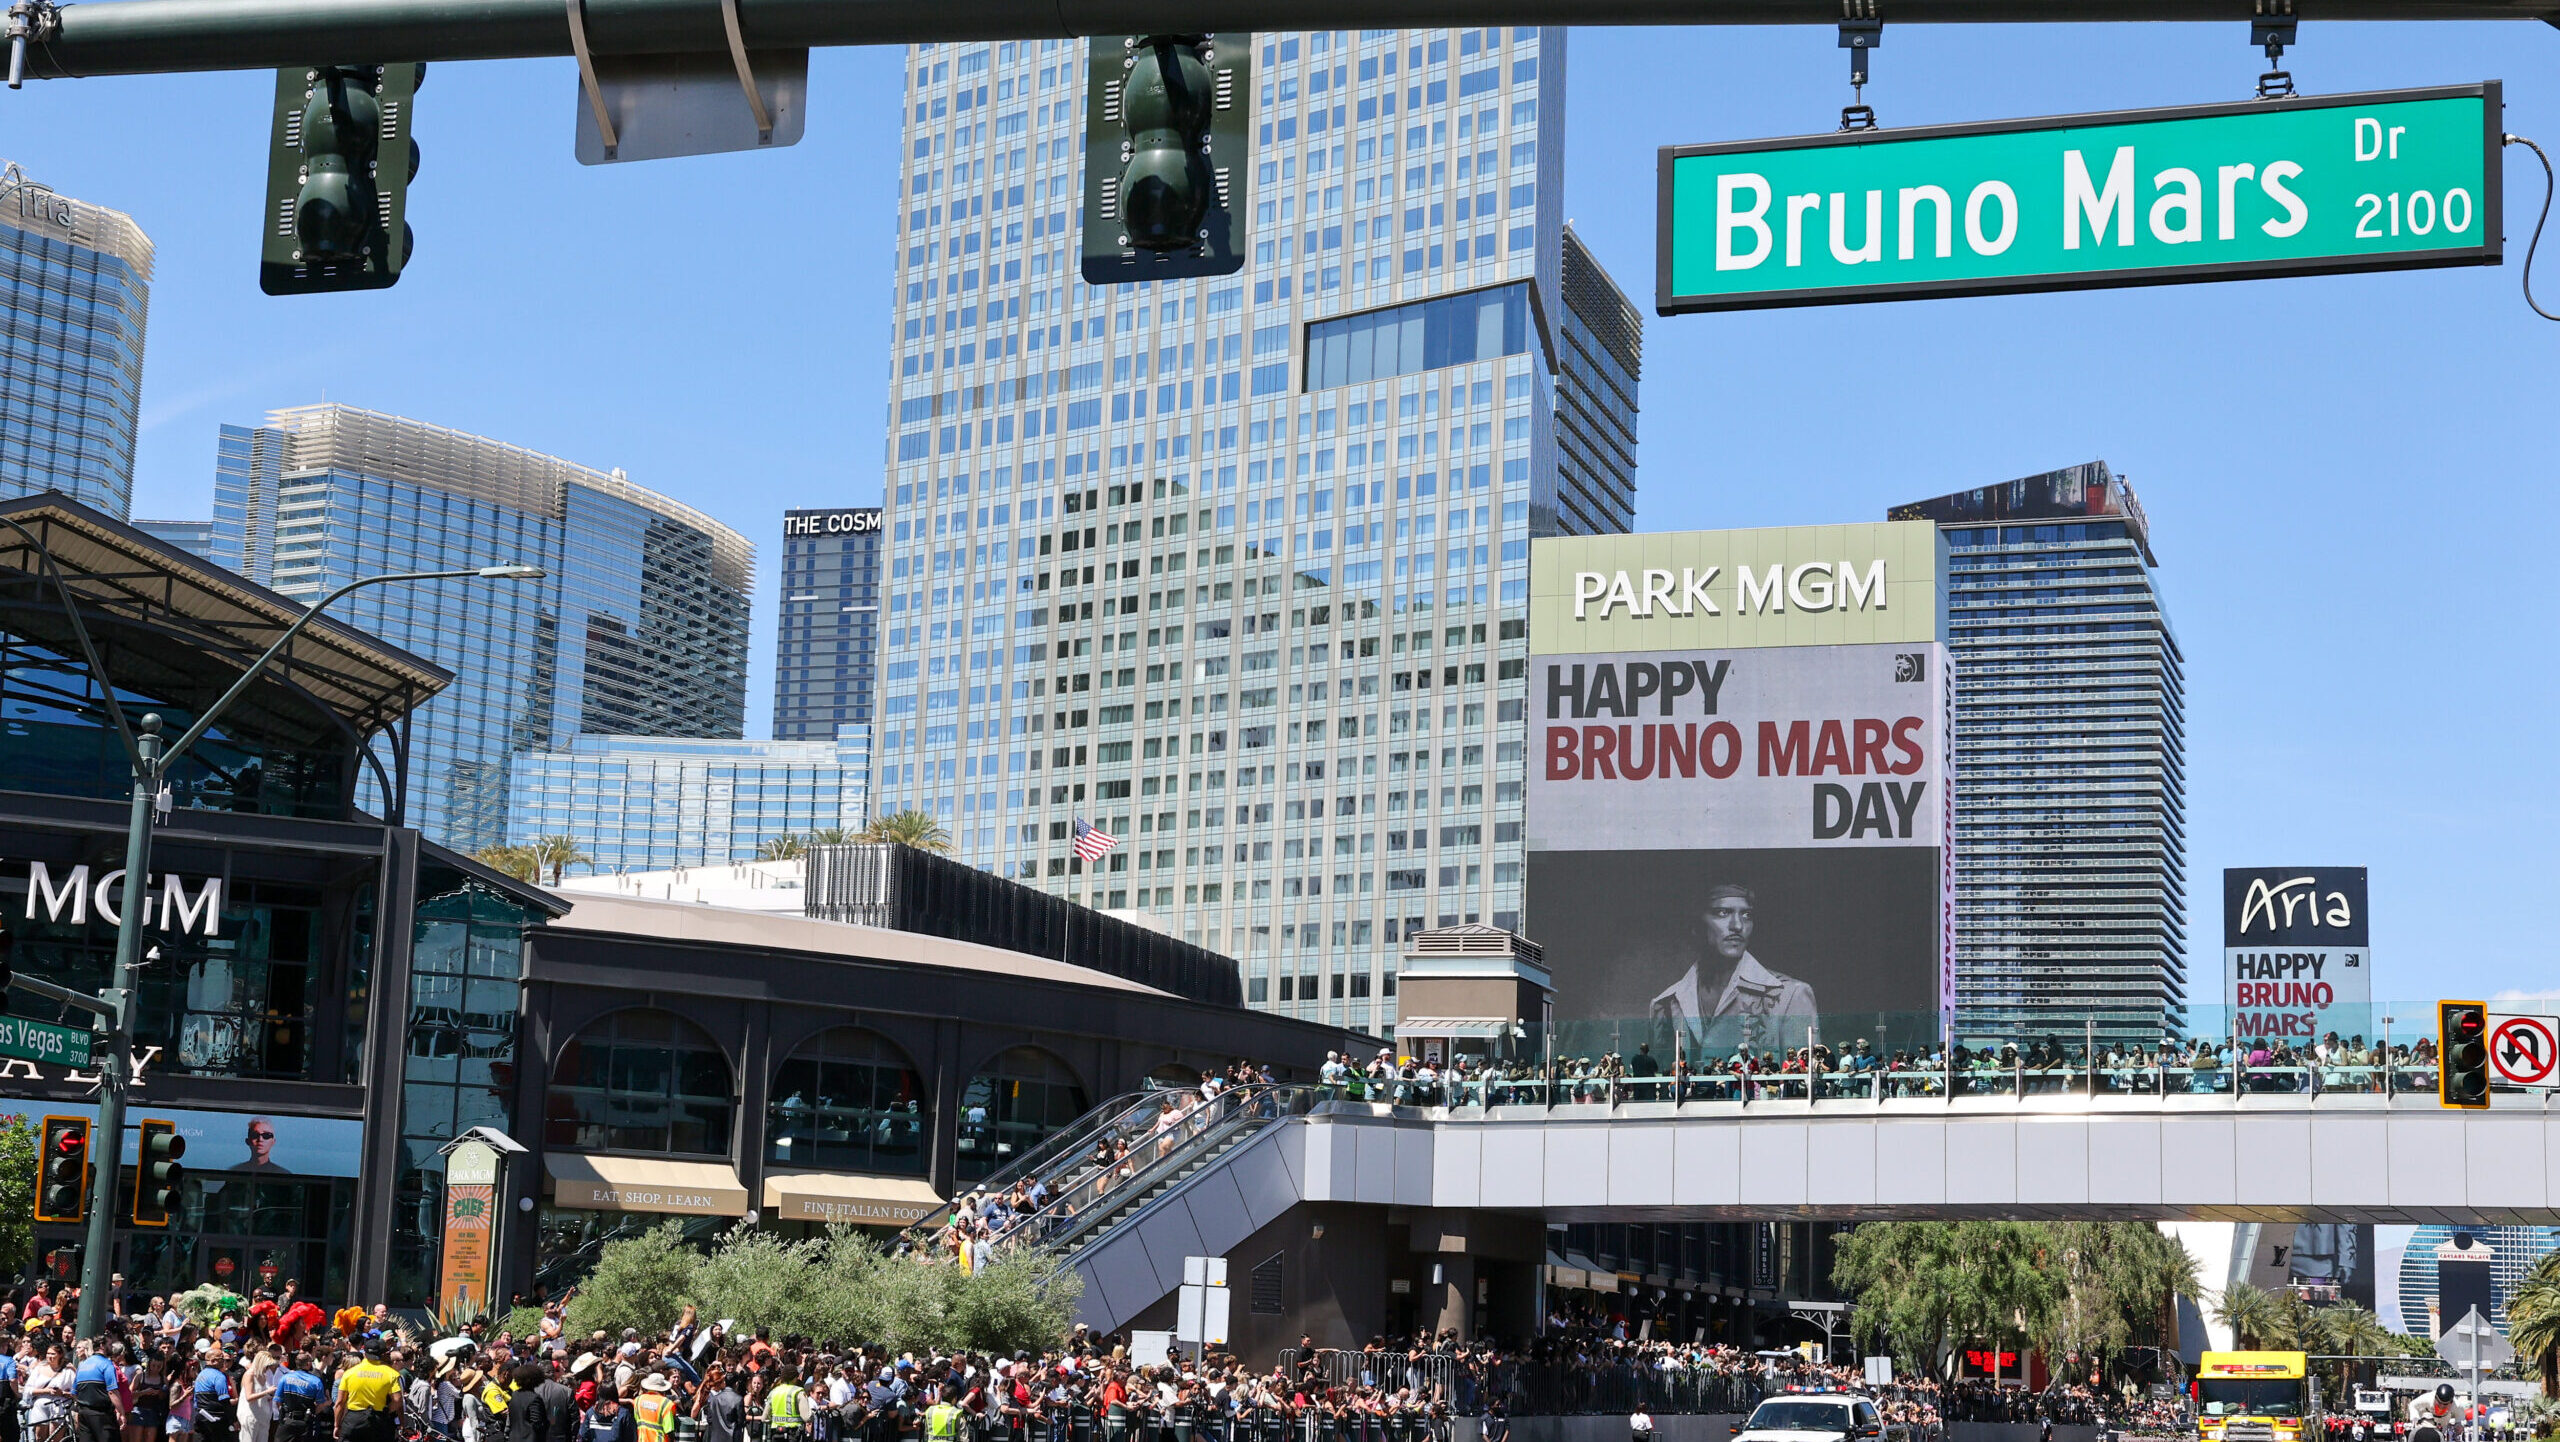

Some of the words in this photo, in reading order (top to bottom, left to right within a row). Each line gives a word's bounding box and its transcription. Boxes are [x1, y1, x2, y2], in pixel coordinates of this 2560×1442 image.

[2355, 117, 2406, 162] Dr
[0, 163, 72, 228] Aria
[1715, 172, 2018, 271] Bruno
[2063, 146, 2309, 250] Mars
[2355, 187, 2472, 239] 2100
[784, 515, 821, 534] THE
[827, 512, 881, 532] COSM
[1574, 566, 1721, 620] PARK
[1737, 559, 1887, 615] MGM
[1546, 659, 1732, 719] HAPPY
[1545, 720, 1743, 781] BRUNO
[1757, 716, 1924, 777] MARS
[1812, 781, 1927, 839] DAY
[25, 860, 222, 936] MGM
[2240, 876, 2351, 934] Aria
[2236, 953, 2327, 980] HAPPY
[2236, 982, 2334, 1010] BRUNO
[18, 1019, 63, 1059] Vegas
[71, 1031, 89, 1046] BLVD
[2236, 1012, 2315, 1037] MARS
[69, 1050, 88, 1065] 3700
[625, 1191, 663, 1205] SHOP.
[667, 1194, 715, 1208] LEARN.
[803, 1201, 832, 1214] FINE
[837, 1203, 890, 1218] ITALIAN
[893, 1207, 929, 1220] FOOD
